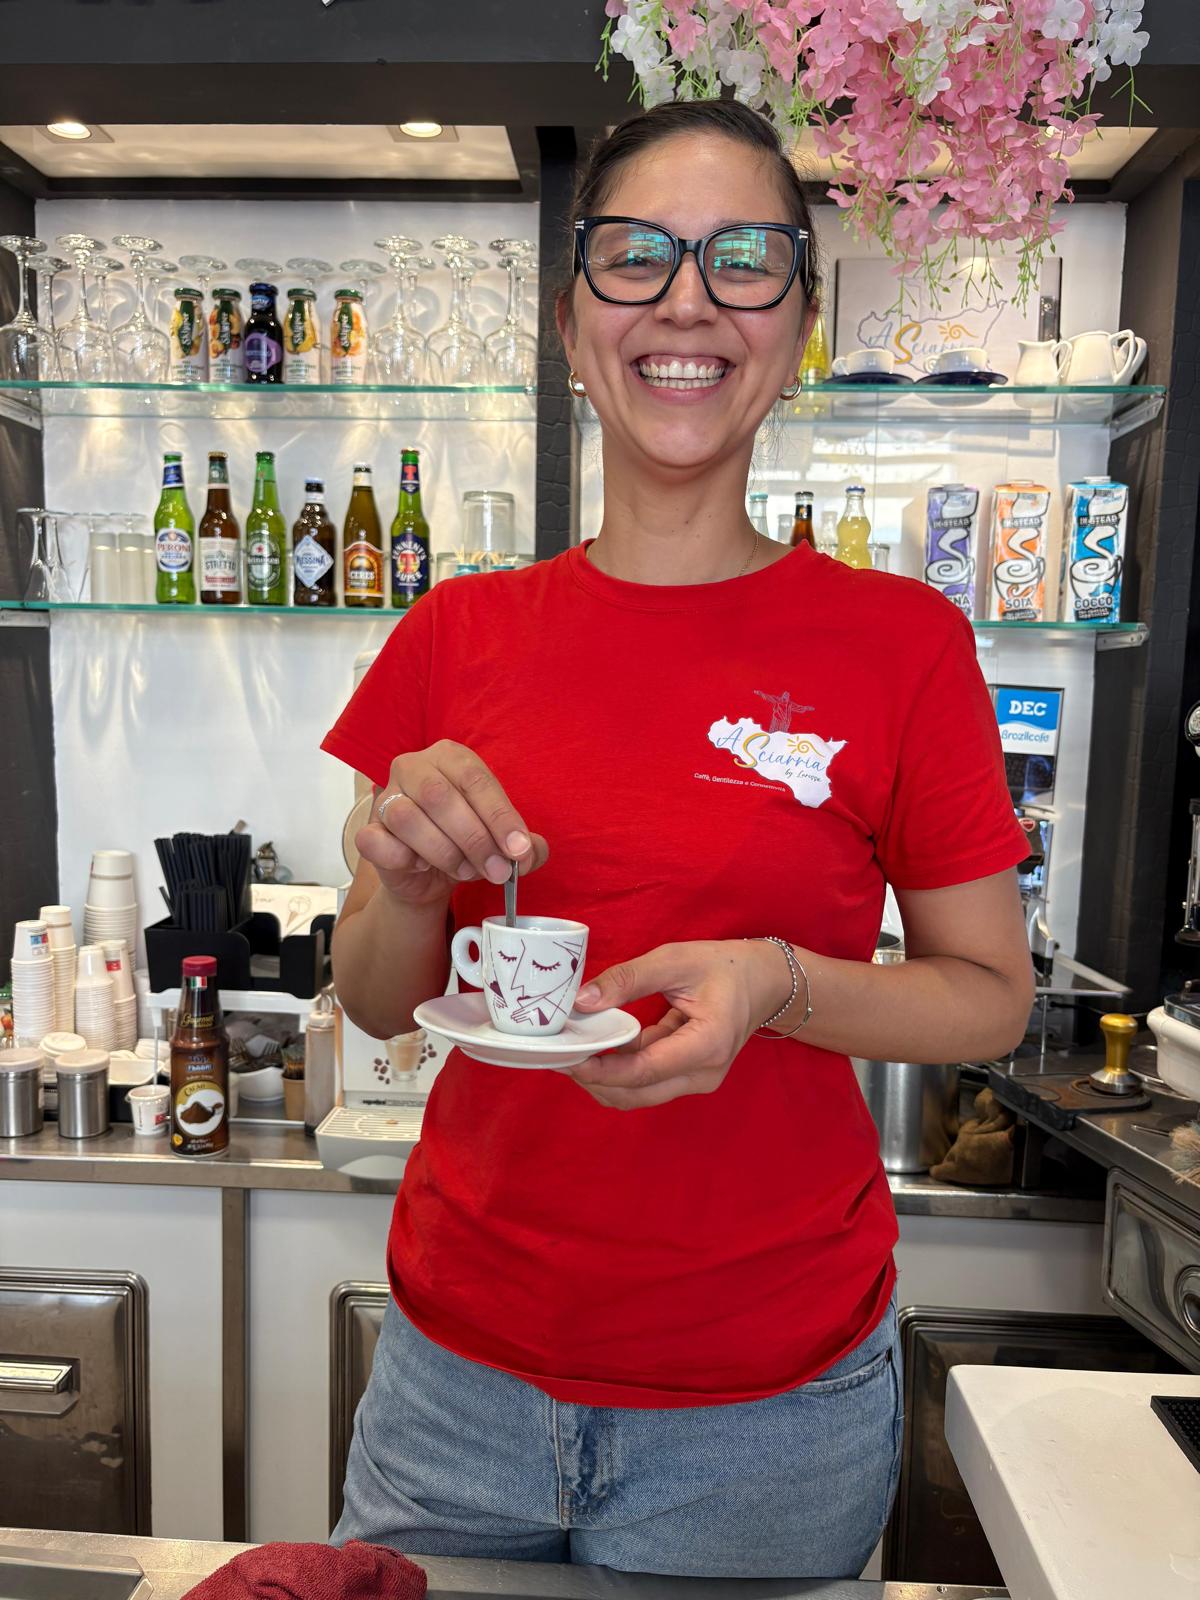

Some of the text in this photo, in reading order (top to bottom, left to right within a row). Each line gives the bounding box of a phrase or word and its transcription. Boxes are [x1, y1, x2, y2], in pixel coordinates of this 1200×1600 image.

[157, 543, 191, 552] PERONI
[350, 570, 375, 580] CERES
[1005, 597, 1033, 609] SOIA
[1074, 596, 1113, 609] COCCO
[1009, 700, 1047, 716] DEC
[716, 726, 743, 751] A
[785, 768, 793, 778] by
